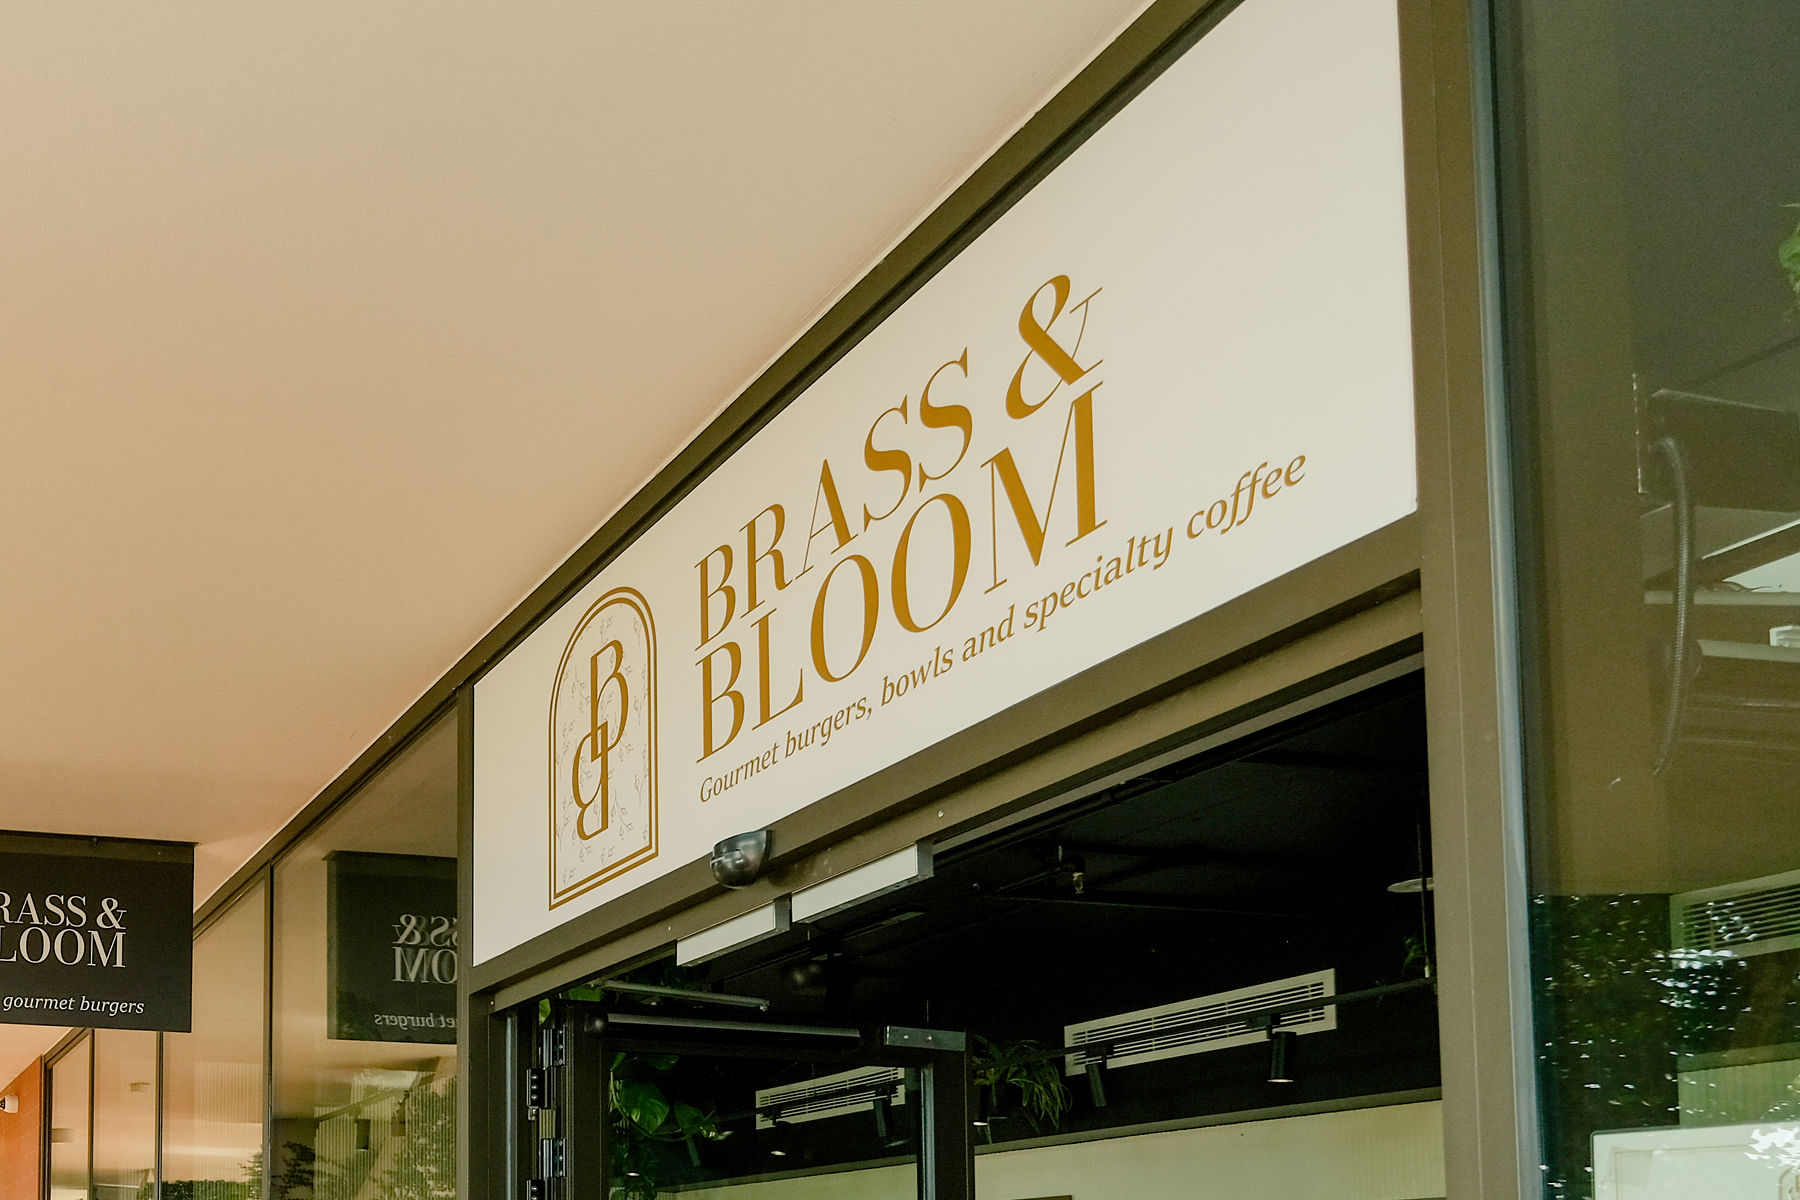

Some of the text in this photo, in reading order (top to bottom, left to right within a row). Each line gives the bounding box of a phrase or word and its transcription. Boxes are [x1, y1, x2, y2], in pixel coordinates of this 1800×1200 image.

[694, 274, 1104, 652] BRASS &
[694, 380, 1110, 764] BLOOM
[698, 453, 1309, 804] Gourmet burgers, bowls and specialty coffee
[1, 995, 76, 1013] gourmet
[79, 996, 145, 1017] burgers
[96, 897, 128, 930] &
